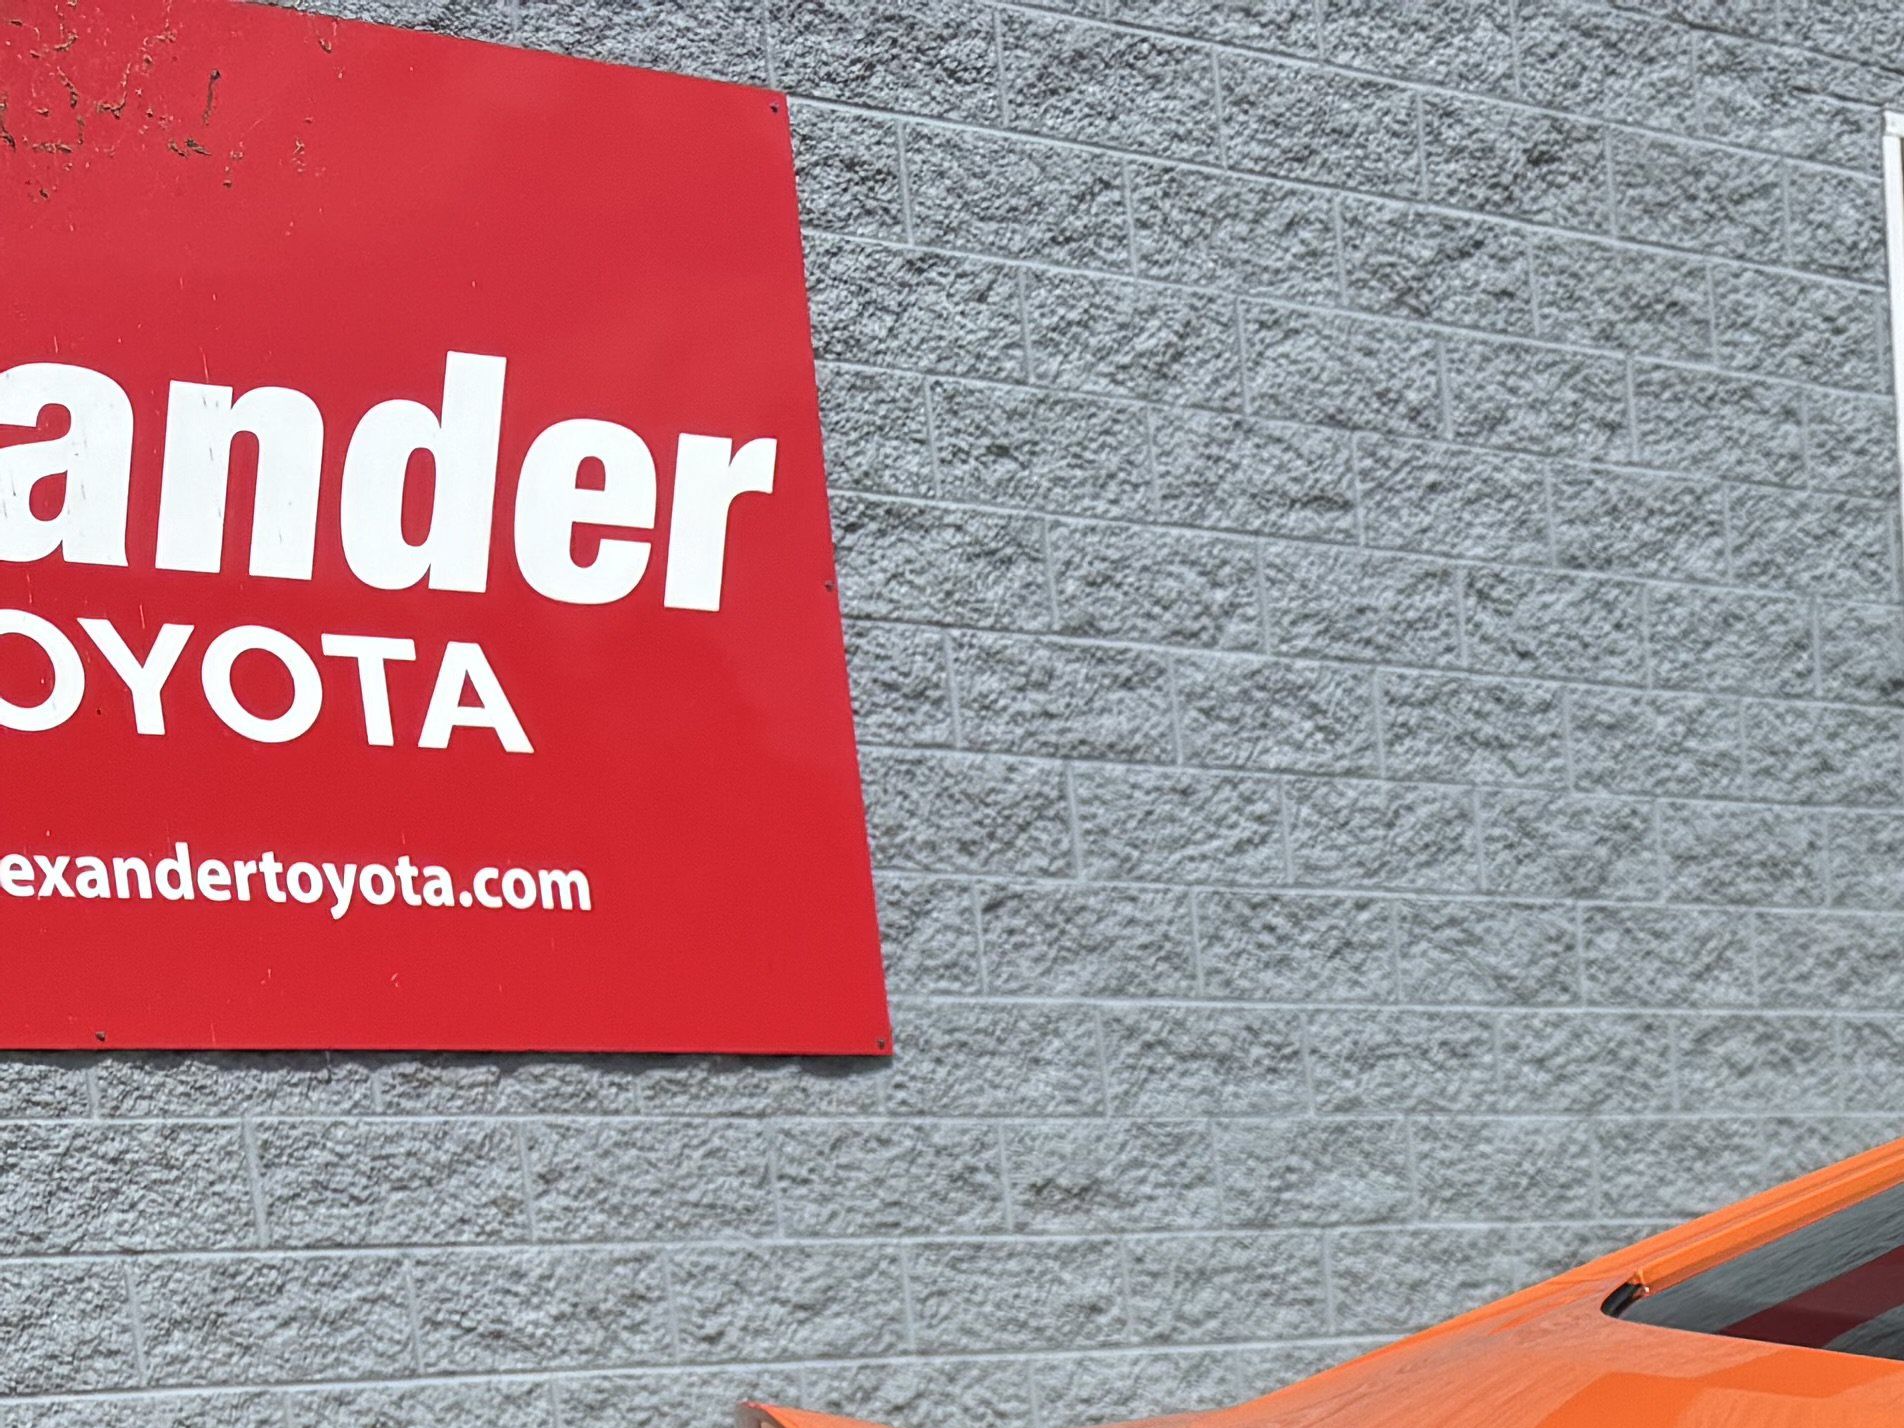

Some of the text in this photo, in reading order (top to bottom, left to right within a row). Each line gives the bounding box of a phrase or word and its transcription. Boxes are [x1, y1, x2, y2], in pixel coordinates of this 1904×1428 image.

[0, 351, 777, 612] ander
[0, 608, 534, 754] OYOTA
[0, 841, 592, 919] exandertoyota.com
